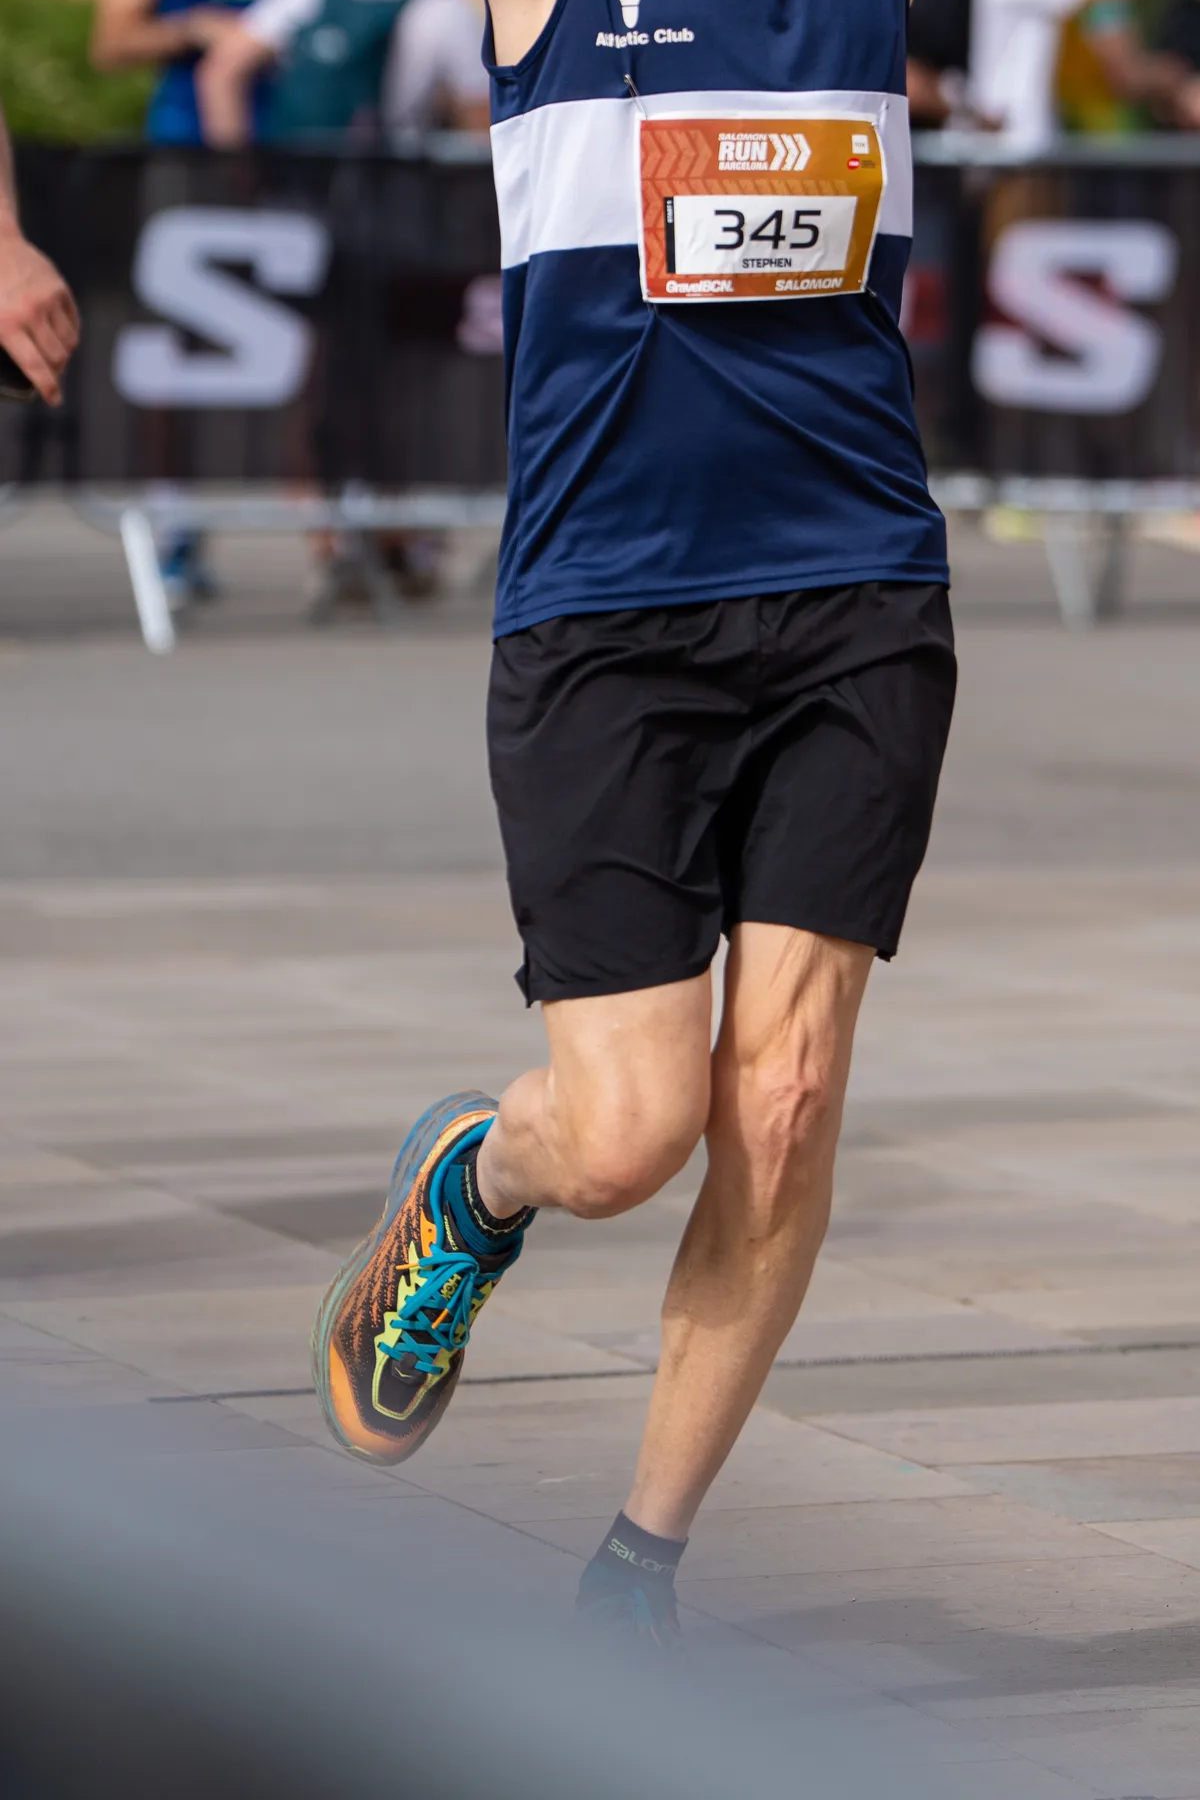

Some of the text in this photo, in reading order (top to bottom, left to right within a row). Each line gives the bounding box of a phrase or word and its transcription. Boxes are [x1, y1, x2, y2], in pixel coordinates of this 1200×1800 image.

[653, 28, 695, 44] Club
[718, 133, 767, 141] SALOMON
[718, 141, 768, 161] RUN
[718, 162, 769, 171] BARCELONA
[714, 209, 822, 251] 345
[742, 257, 792, 269] STEPHEN
[775, 278, 844, 291] SALOMON
[112, 202, 330, 410] S
[970, 218, 1179, 414] S
